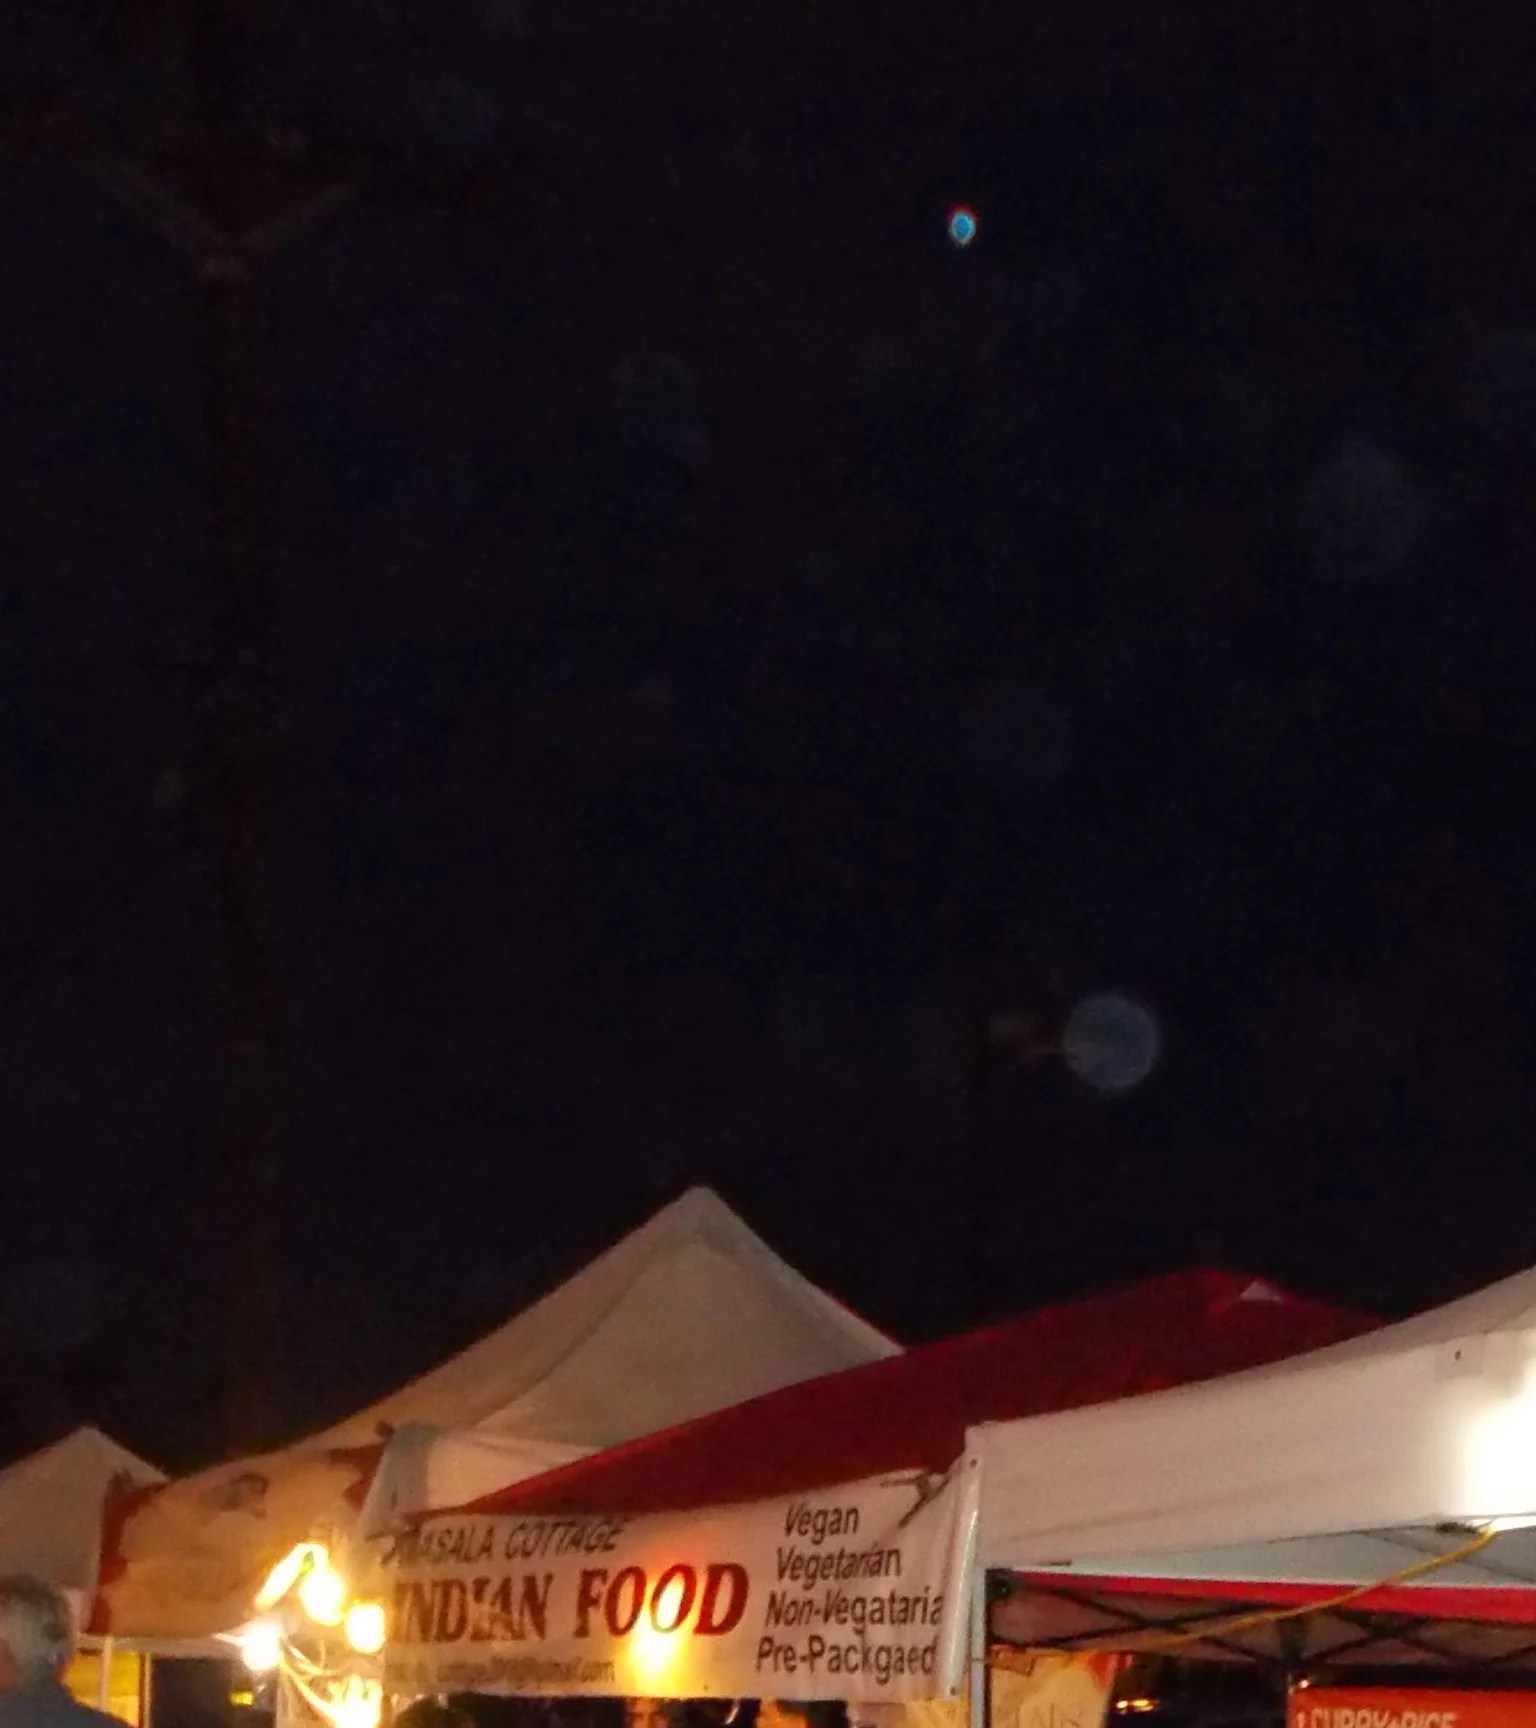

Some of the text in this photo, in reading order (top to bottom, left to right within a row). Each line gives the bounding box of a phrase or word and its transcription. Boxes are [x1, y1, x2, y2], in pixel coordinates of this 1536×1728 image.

[504, 1519, 624, 1561] COTTAGE
[784, 1503, 860, 1546] Vegan
[776, 1546, 902, 1591] Vegetarian
[391, 1563, 749, 1643] INDIAN FOOD
